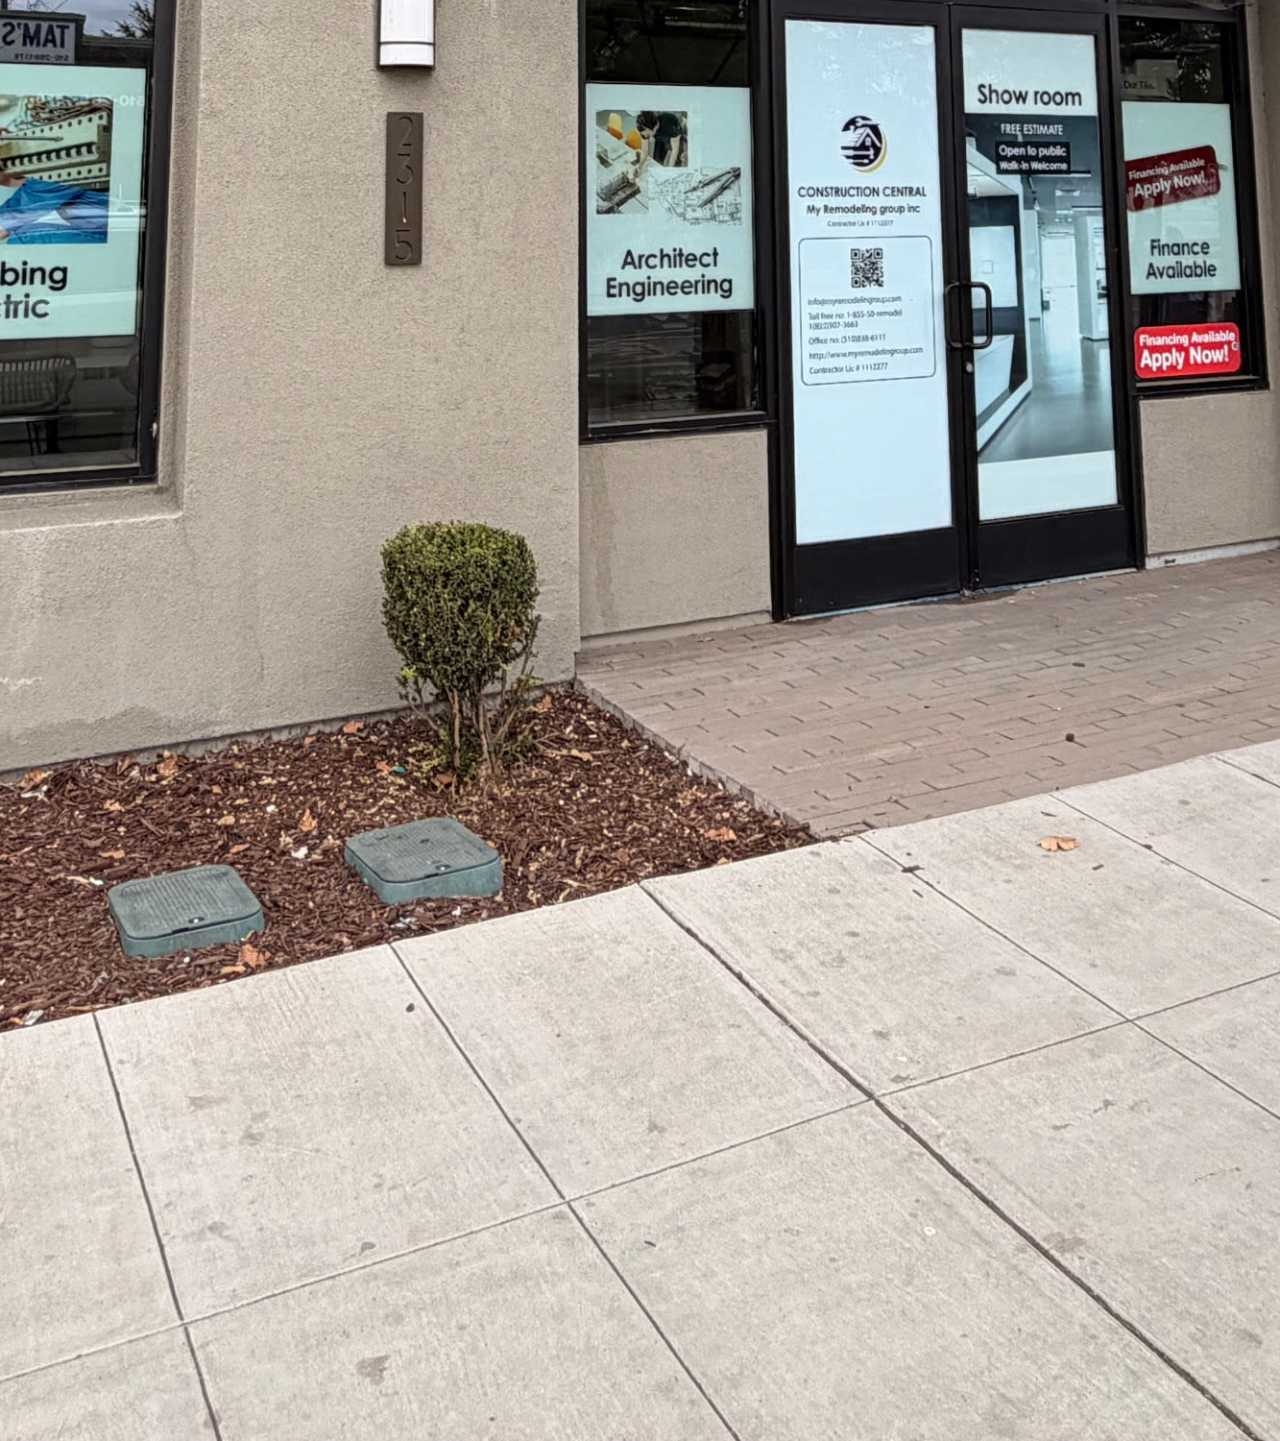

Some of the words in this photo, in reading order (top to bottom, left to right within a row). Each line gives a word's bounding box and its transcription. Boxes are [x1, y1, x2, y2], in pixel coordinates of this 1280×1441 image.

[977, 83, 1028, 105] Show
[1034, 90, 1082, 106] room
[1000, 123, 1022, 135] FREE
[1023, 124, 1064, 136] ESTIMATE
[999, 144, 1026, 157] Open
[1027, 145, 1038, 156] to
[1039, 145, 1067, 158] public
[1030, 161, 1068, 170] Welcome
[1128, 164, 1169, 180] Financing
[394, 115, 415, 261] 2315
[798, 186, 880, 198] CONSTRUCTION
[883, 186, 927, 197] CENTRAL
[1134, 178, 1172, 198] Apply
[1173, 170, 1206, 189] Now!
[807, 206, 821, 217] My
[823, 203, 877, 216] Remodeling
[880, 205, 905, 216] group
[907, 203, 921, 213] inc
[1150, 238, 1210, 257] Finance
[621, 247, 719, 270] Architect
[1145, 260, 1217, 280] Available
[606, 275, 733, 302] Engineering
[1140, 333, 1189, 347] Financing
[1191, 329, 1235, 343] Available
[1140, 346, 1185, 372] Apply
[1189, 344, 1229, 364] Now!
